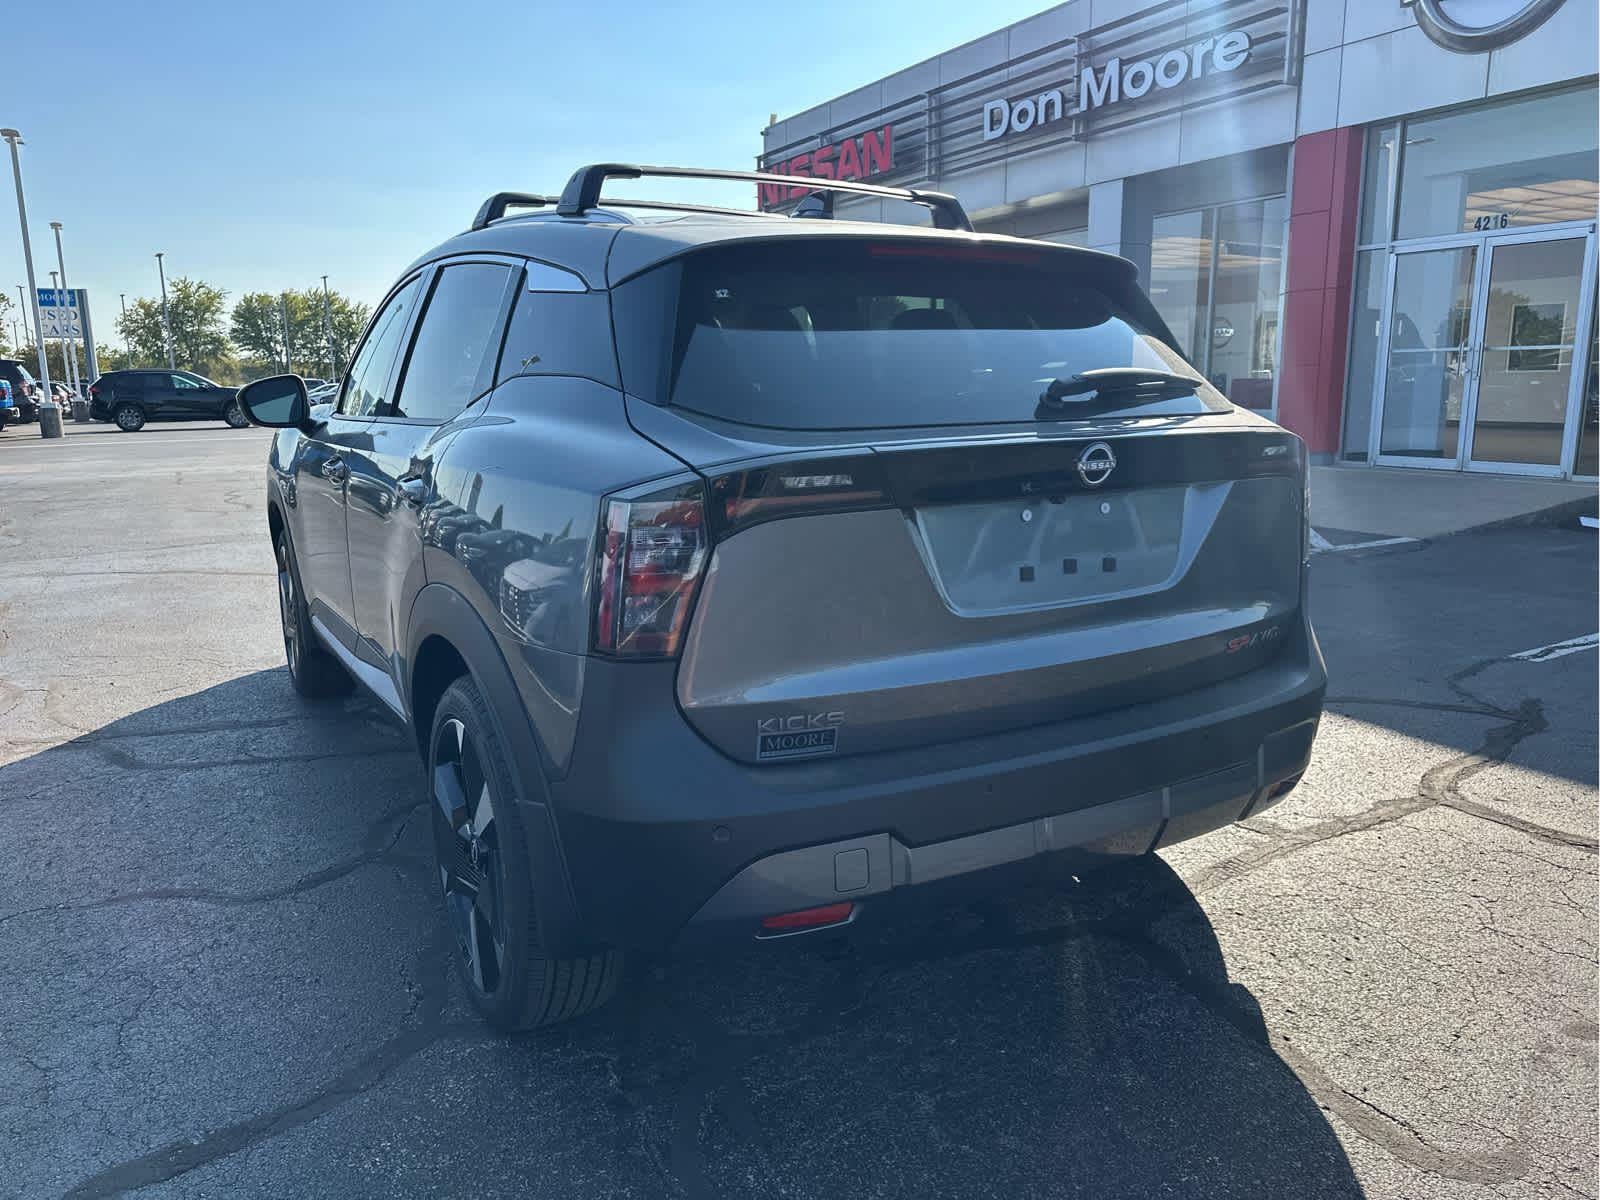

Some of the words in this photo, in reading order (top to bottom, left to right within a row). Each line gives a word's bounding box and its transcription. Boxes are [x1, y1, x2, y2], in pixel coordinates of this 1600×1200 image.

[983, 89, 1064, 141] Don
[1079, 31, 1251, 113] Moore
[757, 124, 892, 212] NISSAN
[1473, 214, 1508, 231] 4216
[1077, 460, 1117, 471] NISSAN
[757, 711, 846, 732] KICKS
[766, 731, 832, 750] MOORE
